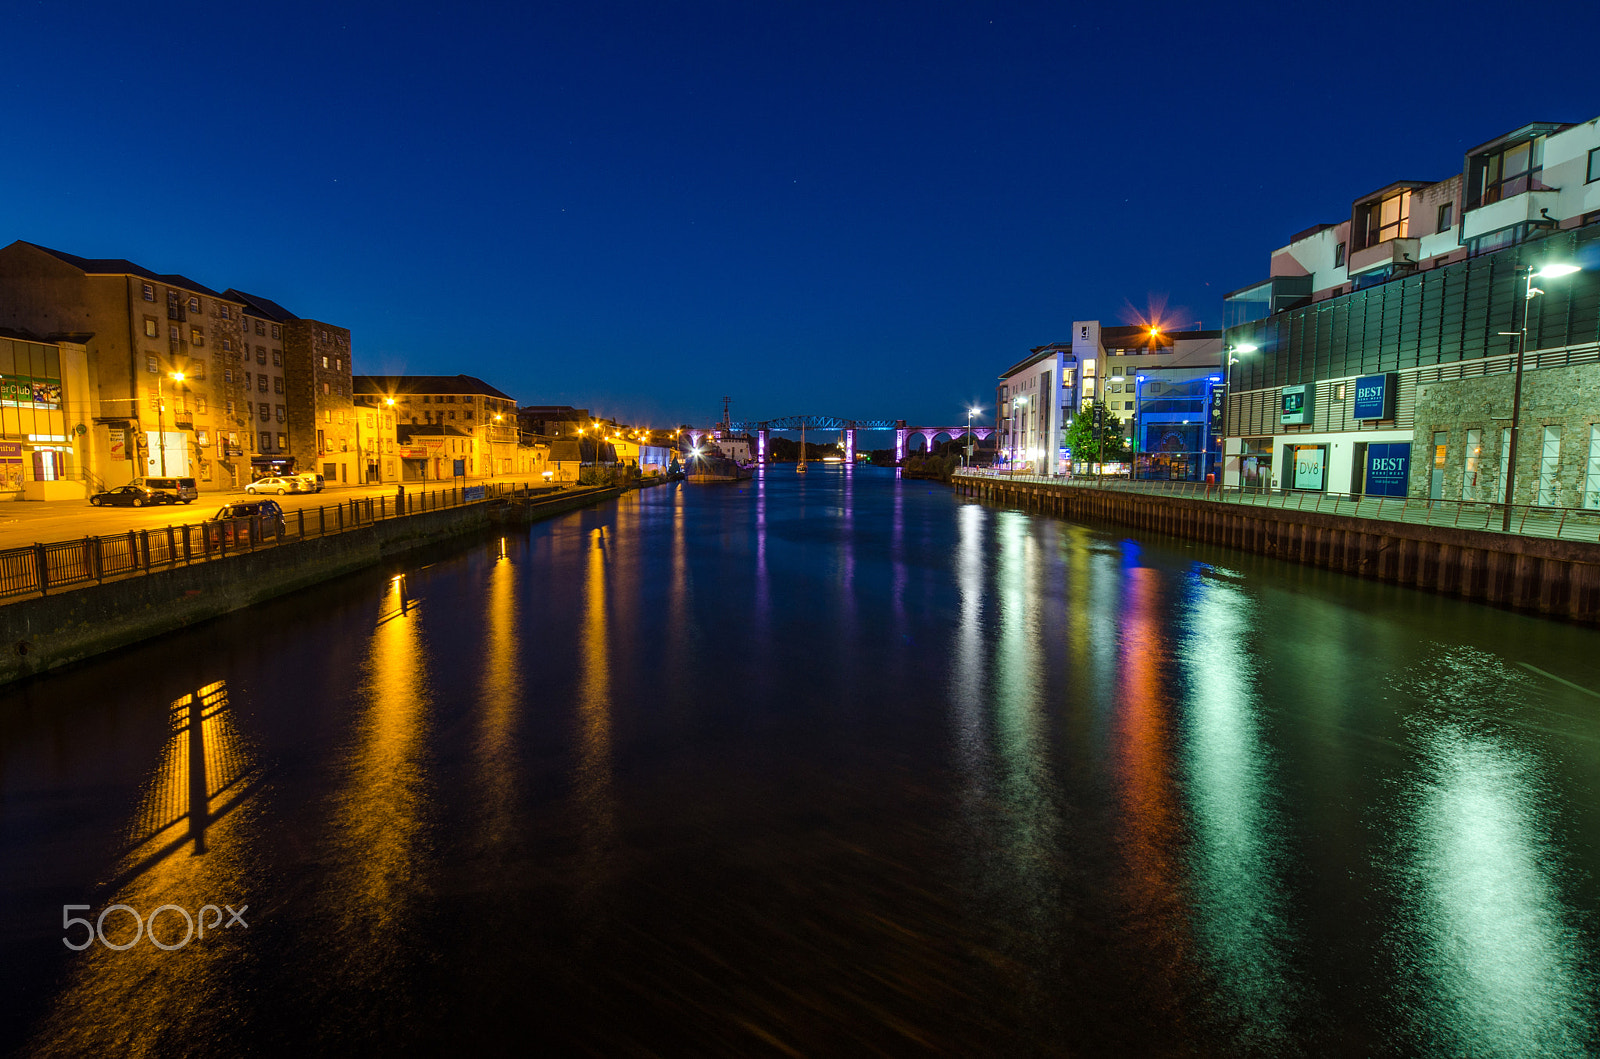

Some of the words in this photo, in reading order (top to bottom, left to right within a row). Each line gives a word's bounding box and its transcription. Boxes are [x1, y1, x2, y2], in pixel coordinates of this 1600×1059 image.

[10, 385, 30, 395] Club
[1358, 386, 1382, 398] BEST
[1299, 462, 1319, 475] DV8
[1372, 458, 1405, 471] BEST
